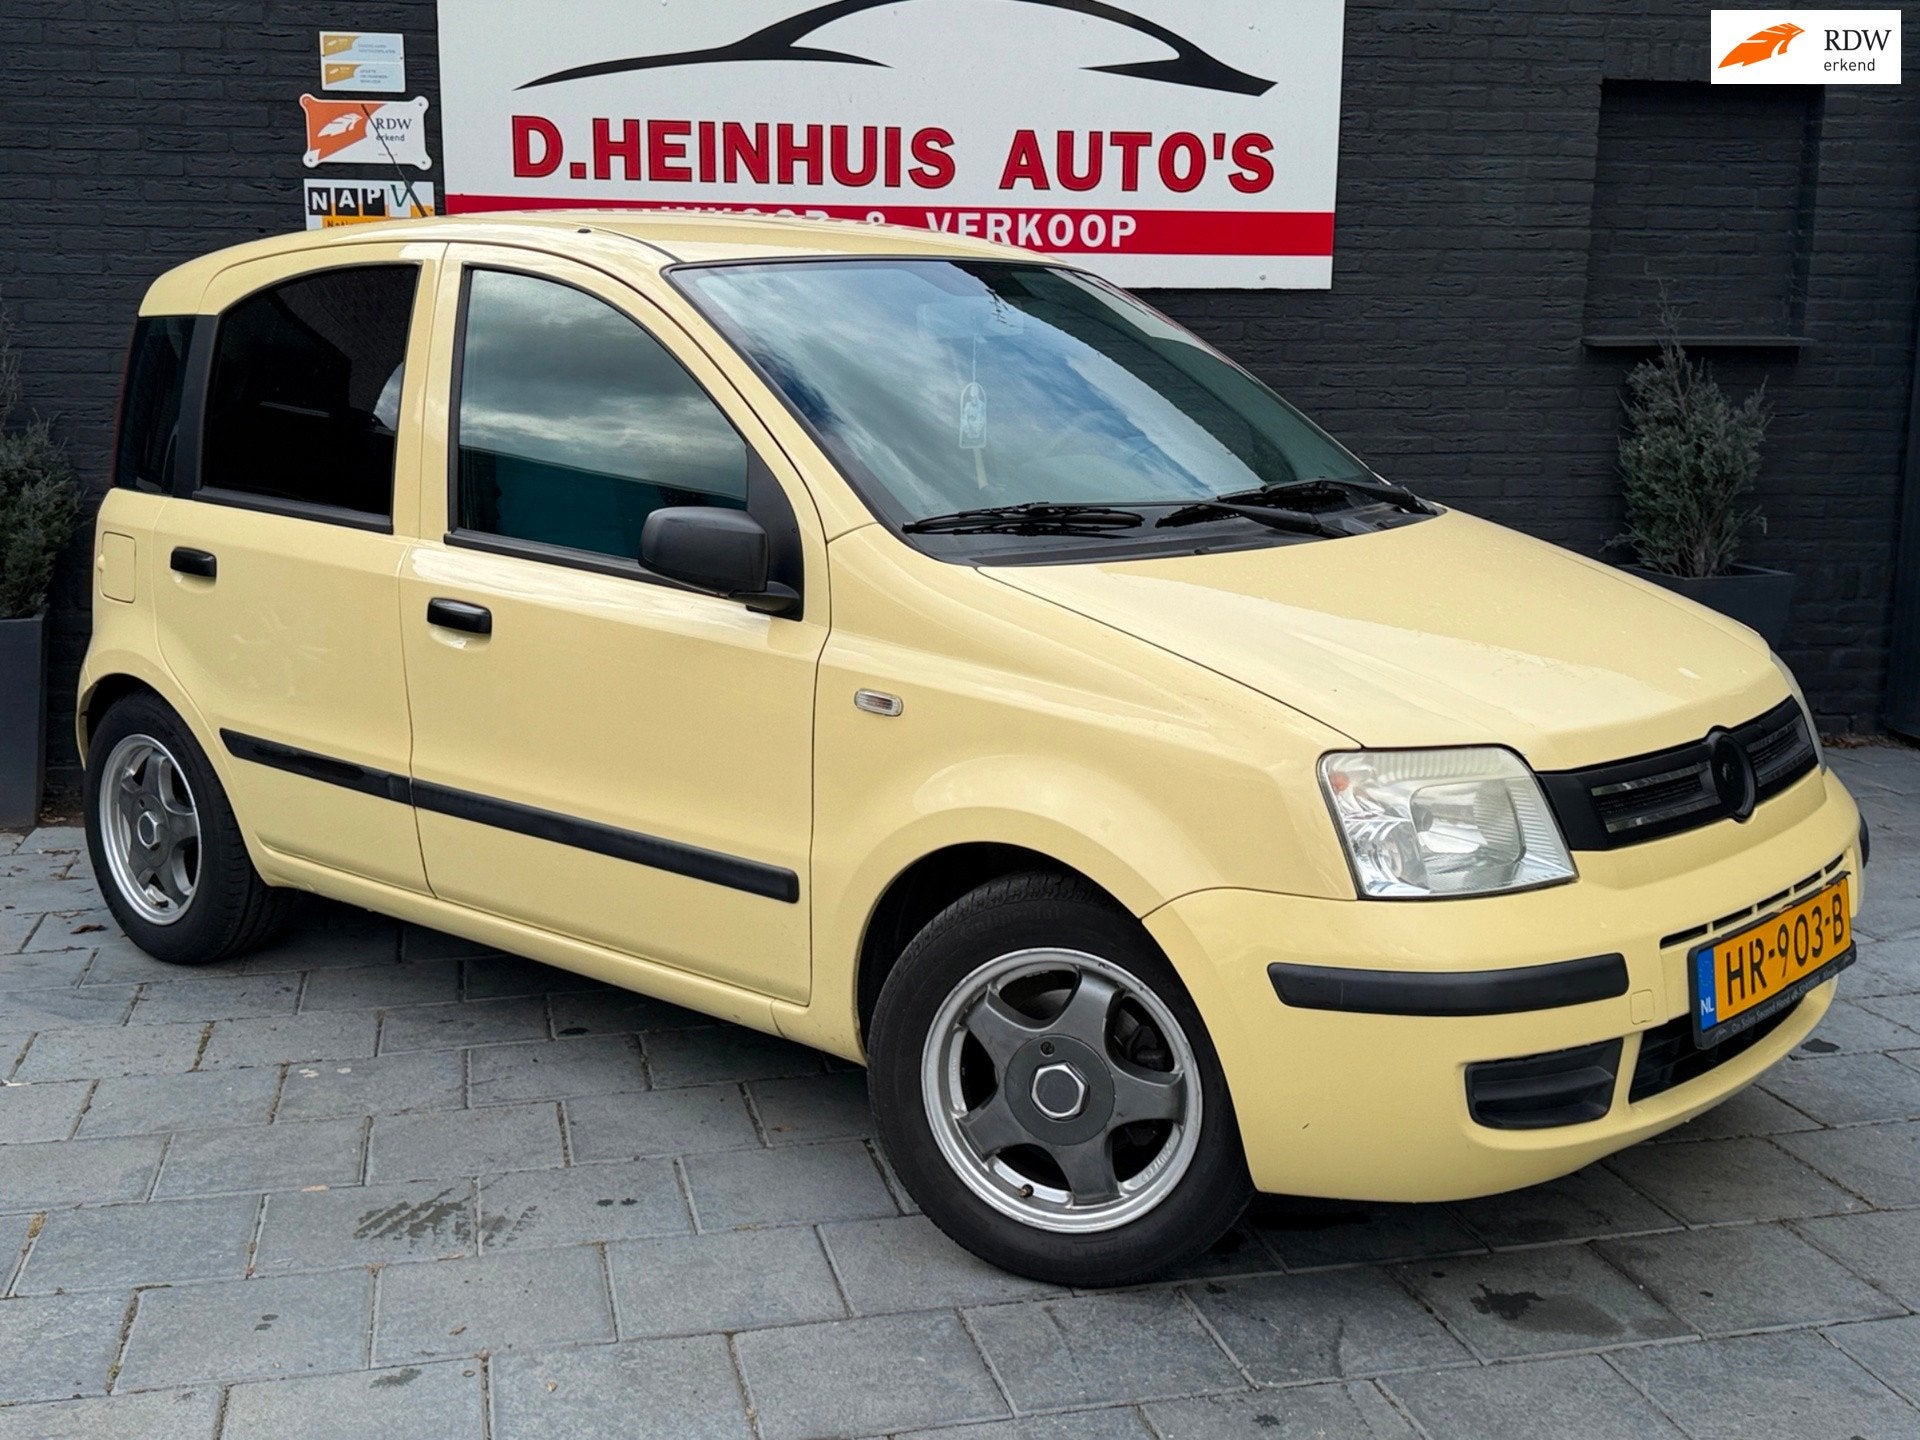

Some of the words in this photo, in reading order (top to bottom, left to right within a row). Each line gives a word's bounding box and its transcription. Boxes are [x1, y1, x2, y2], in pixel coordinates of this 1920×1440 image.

[375, 117, 412, 130] RDW
[375, 133, 405, 142] erkend
[511, 114, 956, 189] D.HEINHUIS
[998, 129, 1275, 194] AUTO'S
[1725, 893, 1845, 1006] HR-903-B
[1700, 996, 1715, 1016] NL
